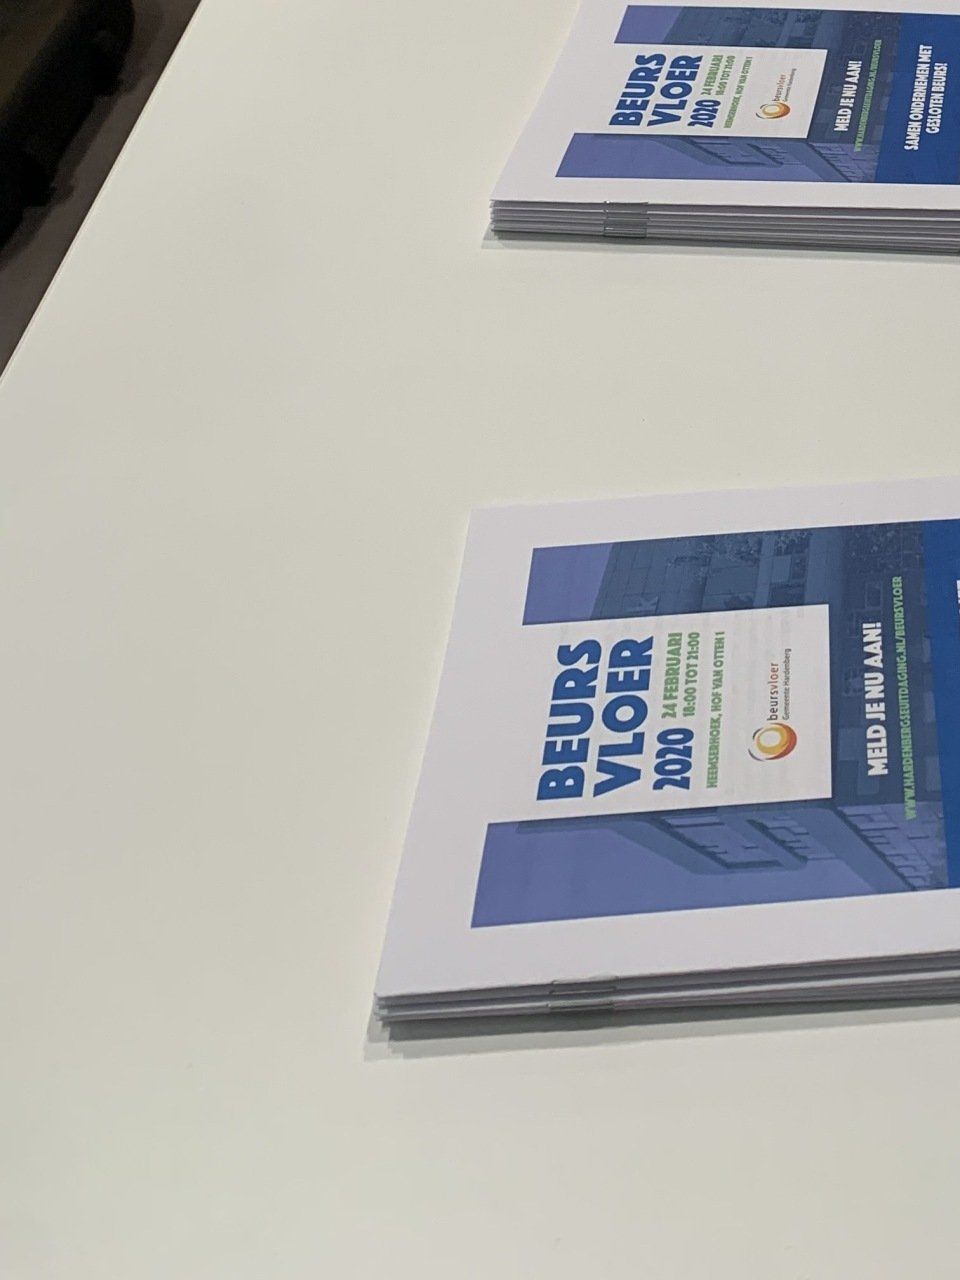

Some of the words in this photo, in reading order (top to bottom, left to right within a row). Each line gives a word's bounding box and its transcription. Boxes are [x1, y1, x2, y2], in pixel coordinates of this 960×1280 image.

[917, 44, 933, 63] MET
[703, 54, 724, 88] FEBRUARI
[844, 60, 863, 84] AAN!
[931, 62, 948, 93] BEURS!
[609, 54, 666, 126] BEURS
[647, 56, 703, 126] VLOER
[699, 87, 713, 96] 24
[839, 97, 855, 108] JE
[841, 84, 858, 97] NU
[908, 63, 931, 121] ONDERNEMEN
[687, 99, 722, 129] 2020
[833, 107, 853, 132] MELD
[925, 92, 945, 134] GESLOTEN
[903, 121, 923, 151] SAMEN
[685, 631, 701, 661] 21:00
[712, 636, 725, 669] OTTEN
[861, 621, 884, 669] AAN!
[662, 631, 683, 701] FEBRUARI
[684, 662, 699, 686] TOT
[711, 669, 724, 691] VAN
[782, 647, 793, 687] Hardenberg
[766, 662, 779, 721] beursvloer
[863, 671, 885, 700] NU
[593, 636, 654, 798] VLOER
[660, 702, 678, 720] 24
[682, 686, 697, 718] 18:00
[710, 691, 723, 713] HOF
[781, 686, 791, 721] Gemeente
[865, 701, 886, 721] JE
[536, 640, 602, 800] BEURS
[652, 728, 694, 790] 2020
[705, 713, 723, 789] HEEMSERHOEK,
[865, 724, 889, 776] MELD
